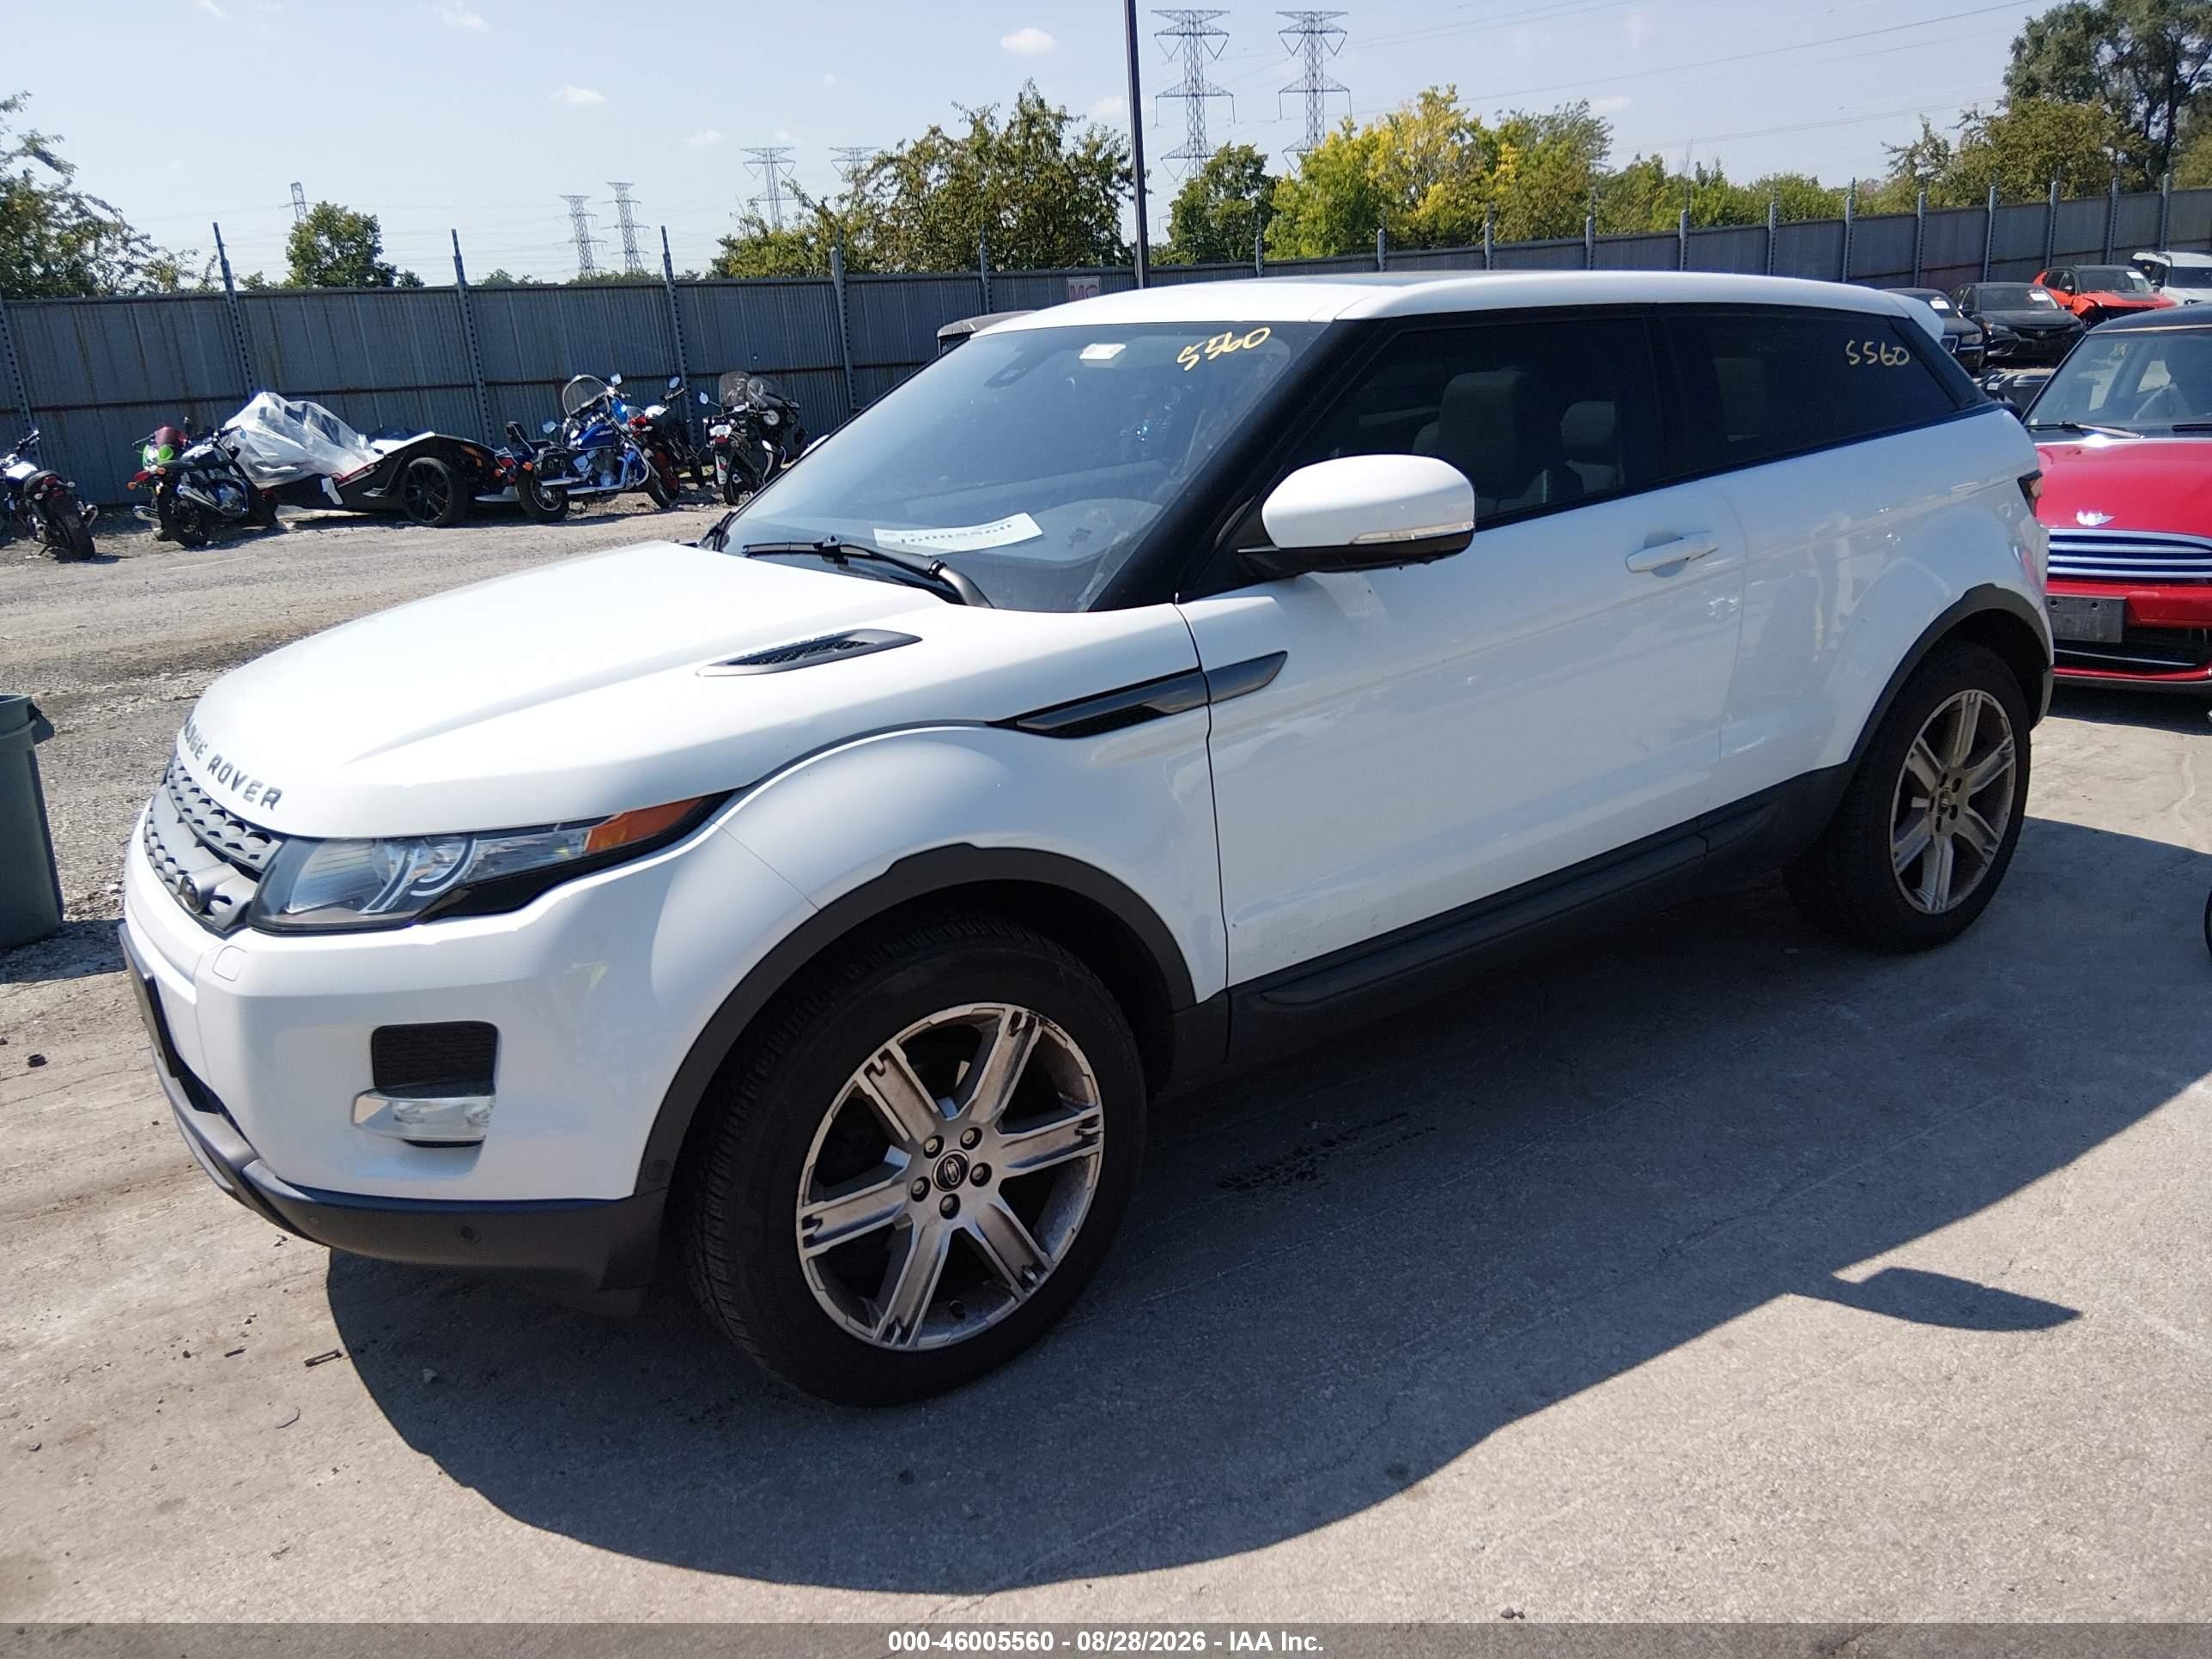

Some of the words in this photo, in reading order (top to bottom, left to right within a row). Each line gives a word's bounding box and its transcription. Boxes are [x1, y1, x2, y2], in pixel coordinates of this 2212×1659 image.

[1176, 326, 1272, 371] 5560
[1844, 339, 1911, 367] 5560
[206, 753, 283, 811] ROVER
